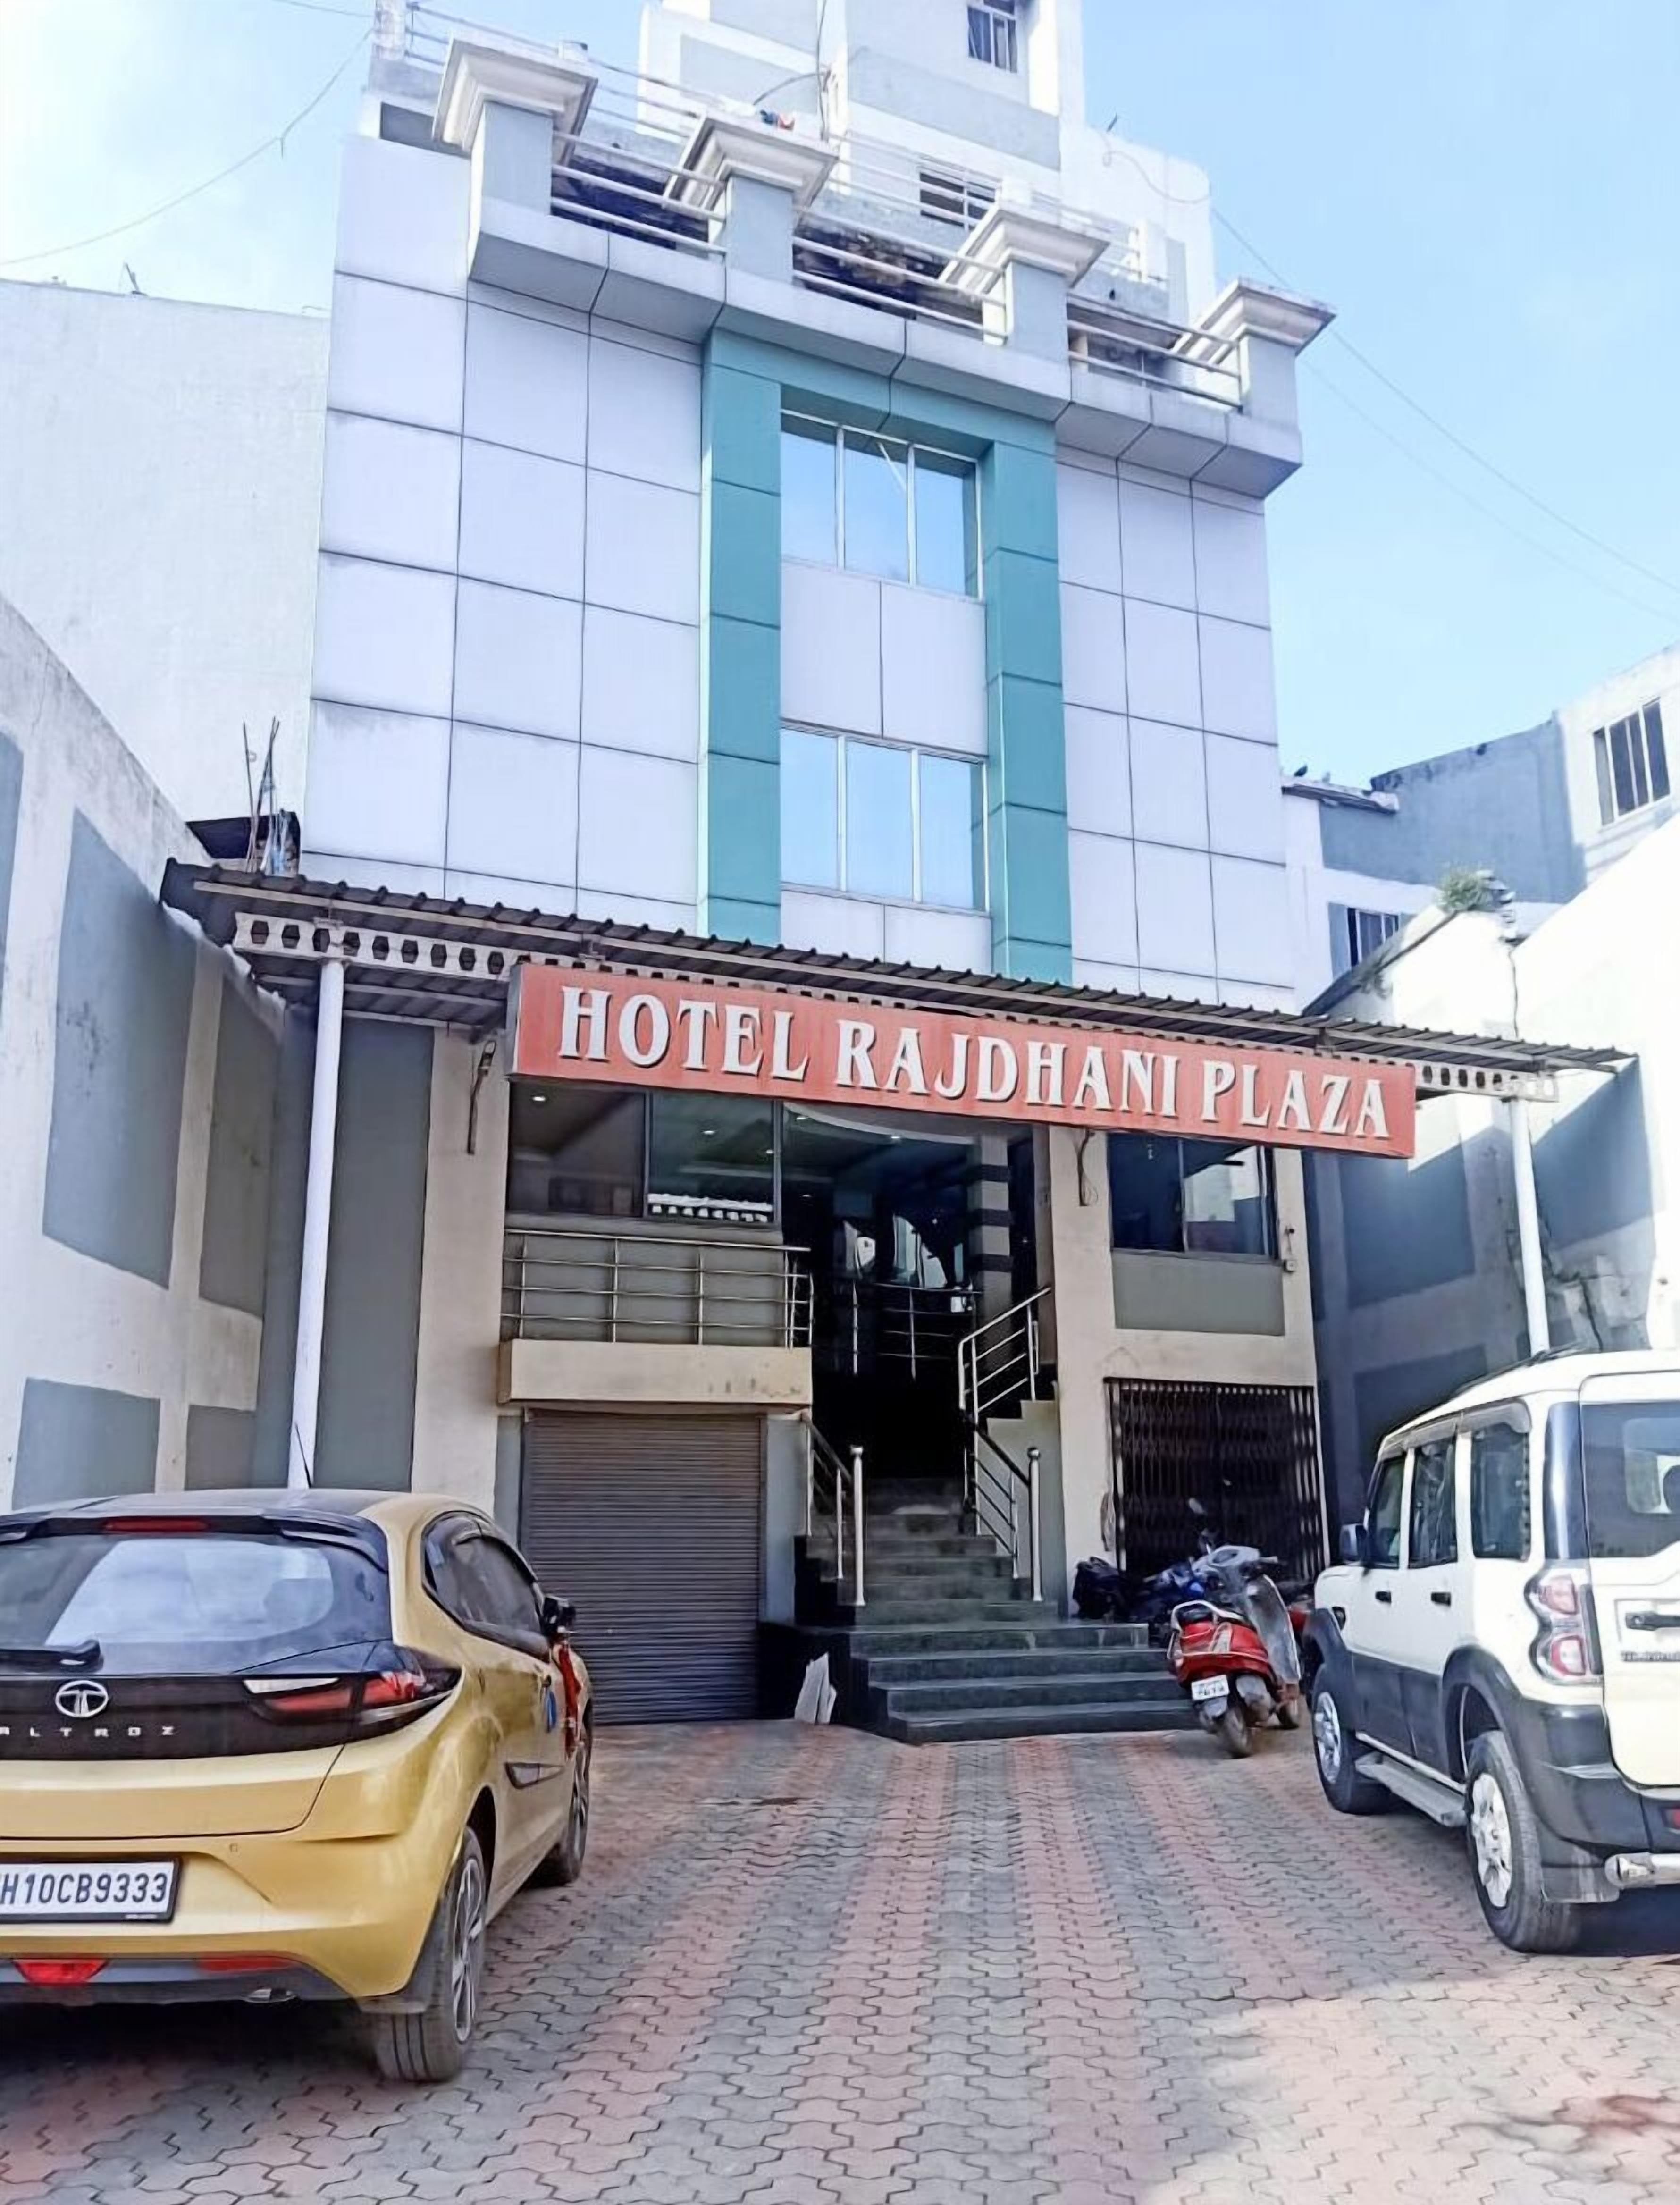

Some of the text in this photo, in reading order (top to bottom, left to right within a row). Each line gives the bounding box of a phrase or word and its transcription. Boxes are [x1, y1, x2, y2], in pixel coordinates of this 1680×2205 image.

[559, 985, 1390, 1138] HOTEL RAJDHANI PLAZA
[0, 1872, 168, 1905] H10CB9333
